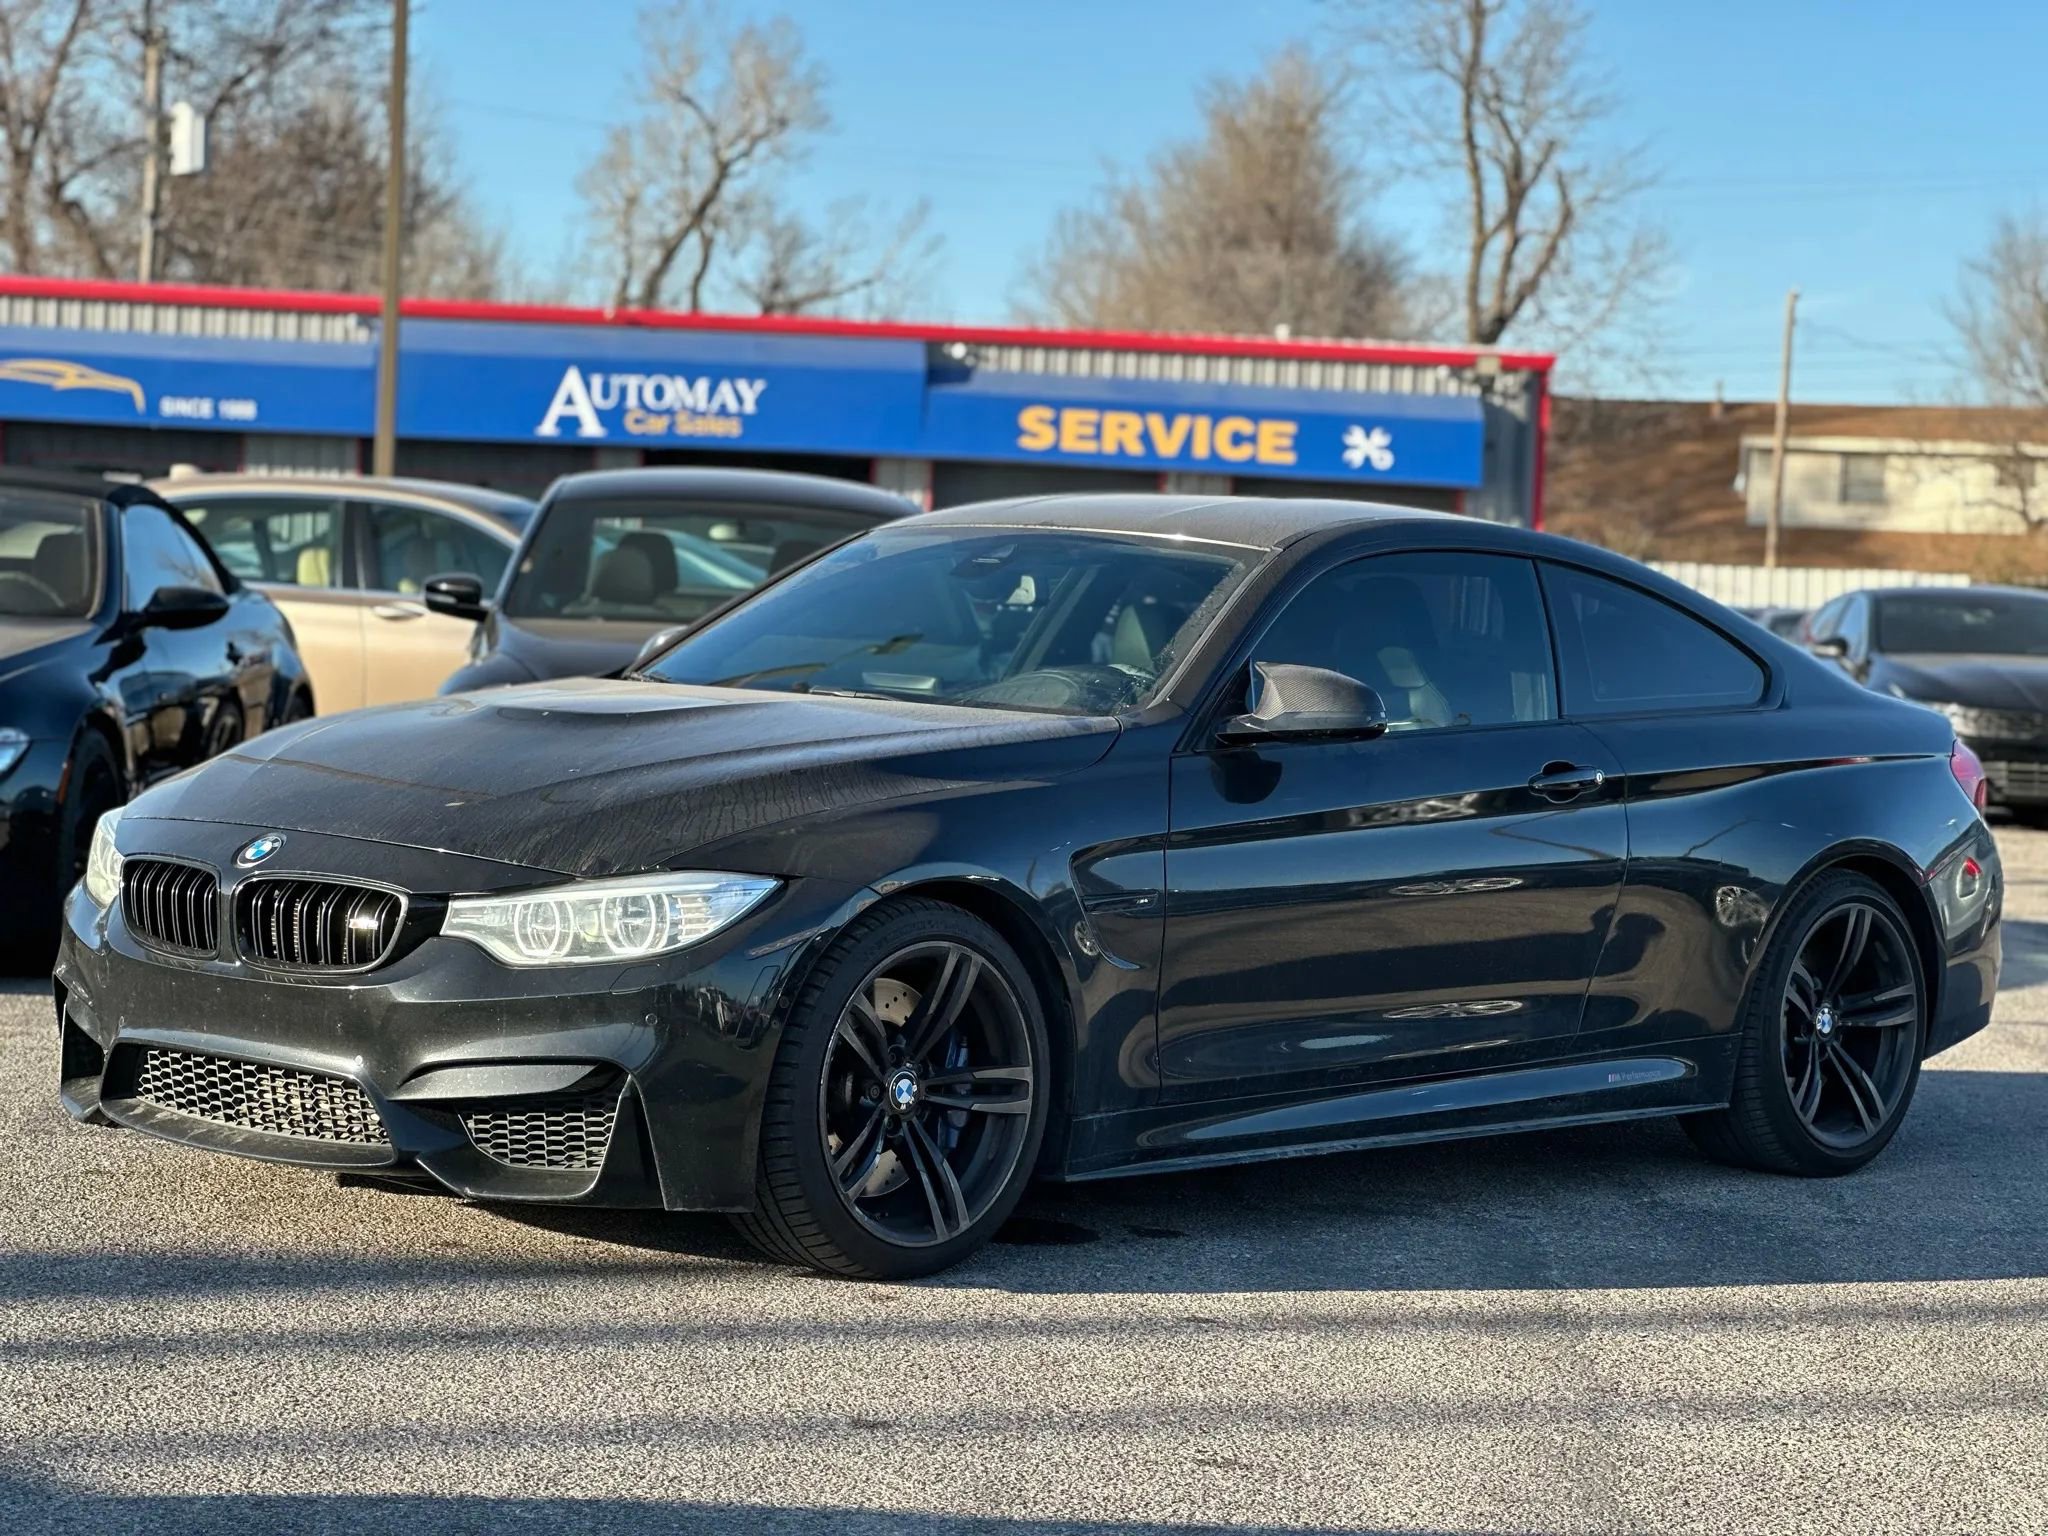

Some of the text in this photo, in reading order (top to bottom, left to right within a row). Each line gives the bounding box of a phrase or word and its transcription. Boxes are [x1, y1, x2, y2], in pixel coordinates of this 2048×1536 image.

[159, 396, 214, 419] SINCE
[534, 365, 767, 438] AUTOMAY
[623, 409, 742, 438] Car Sales
[1017, 405, 1298, 465] SERVICE
